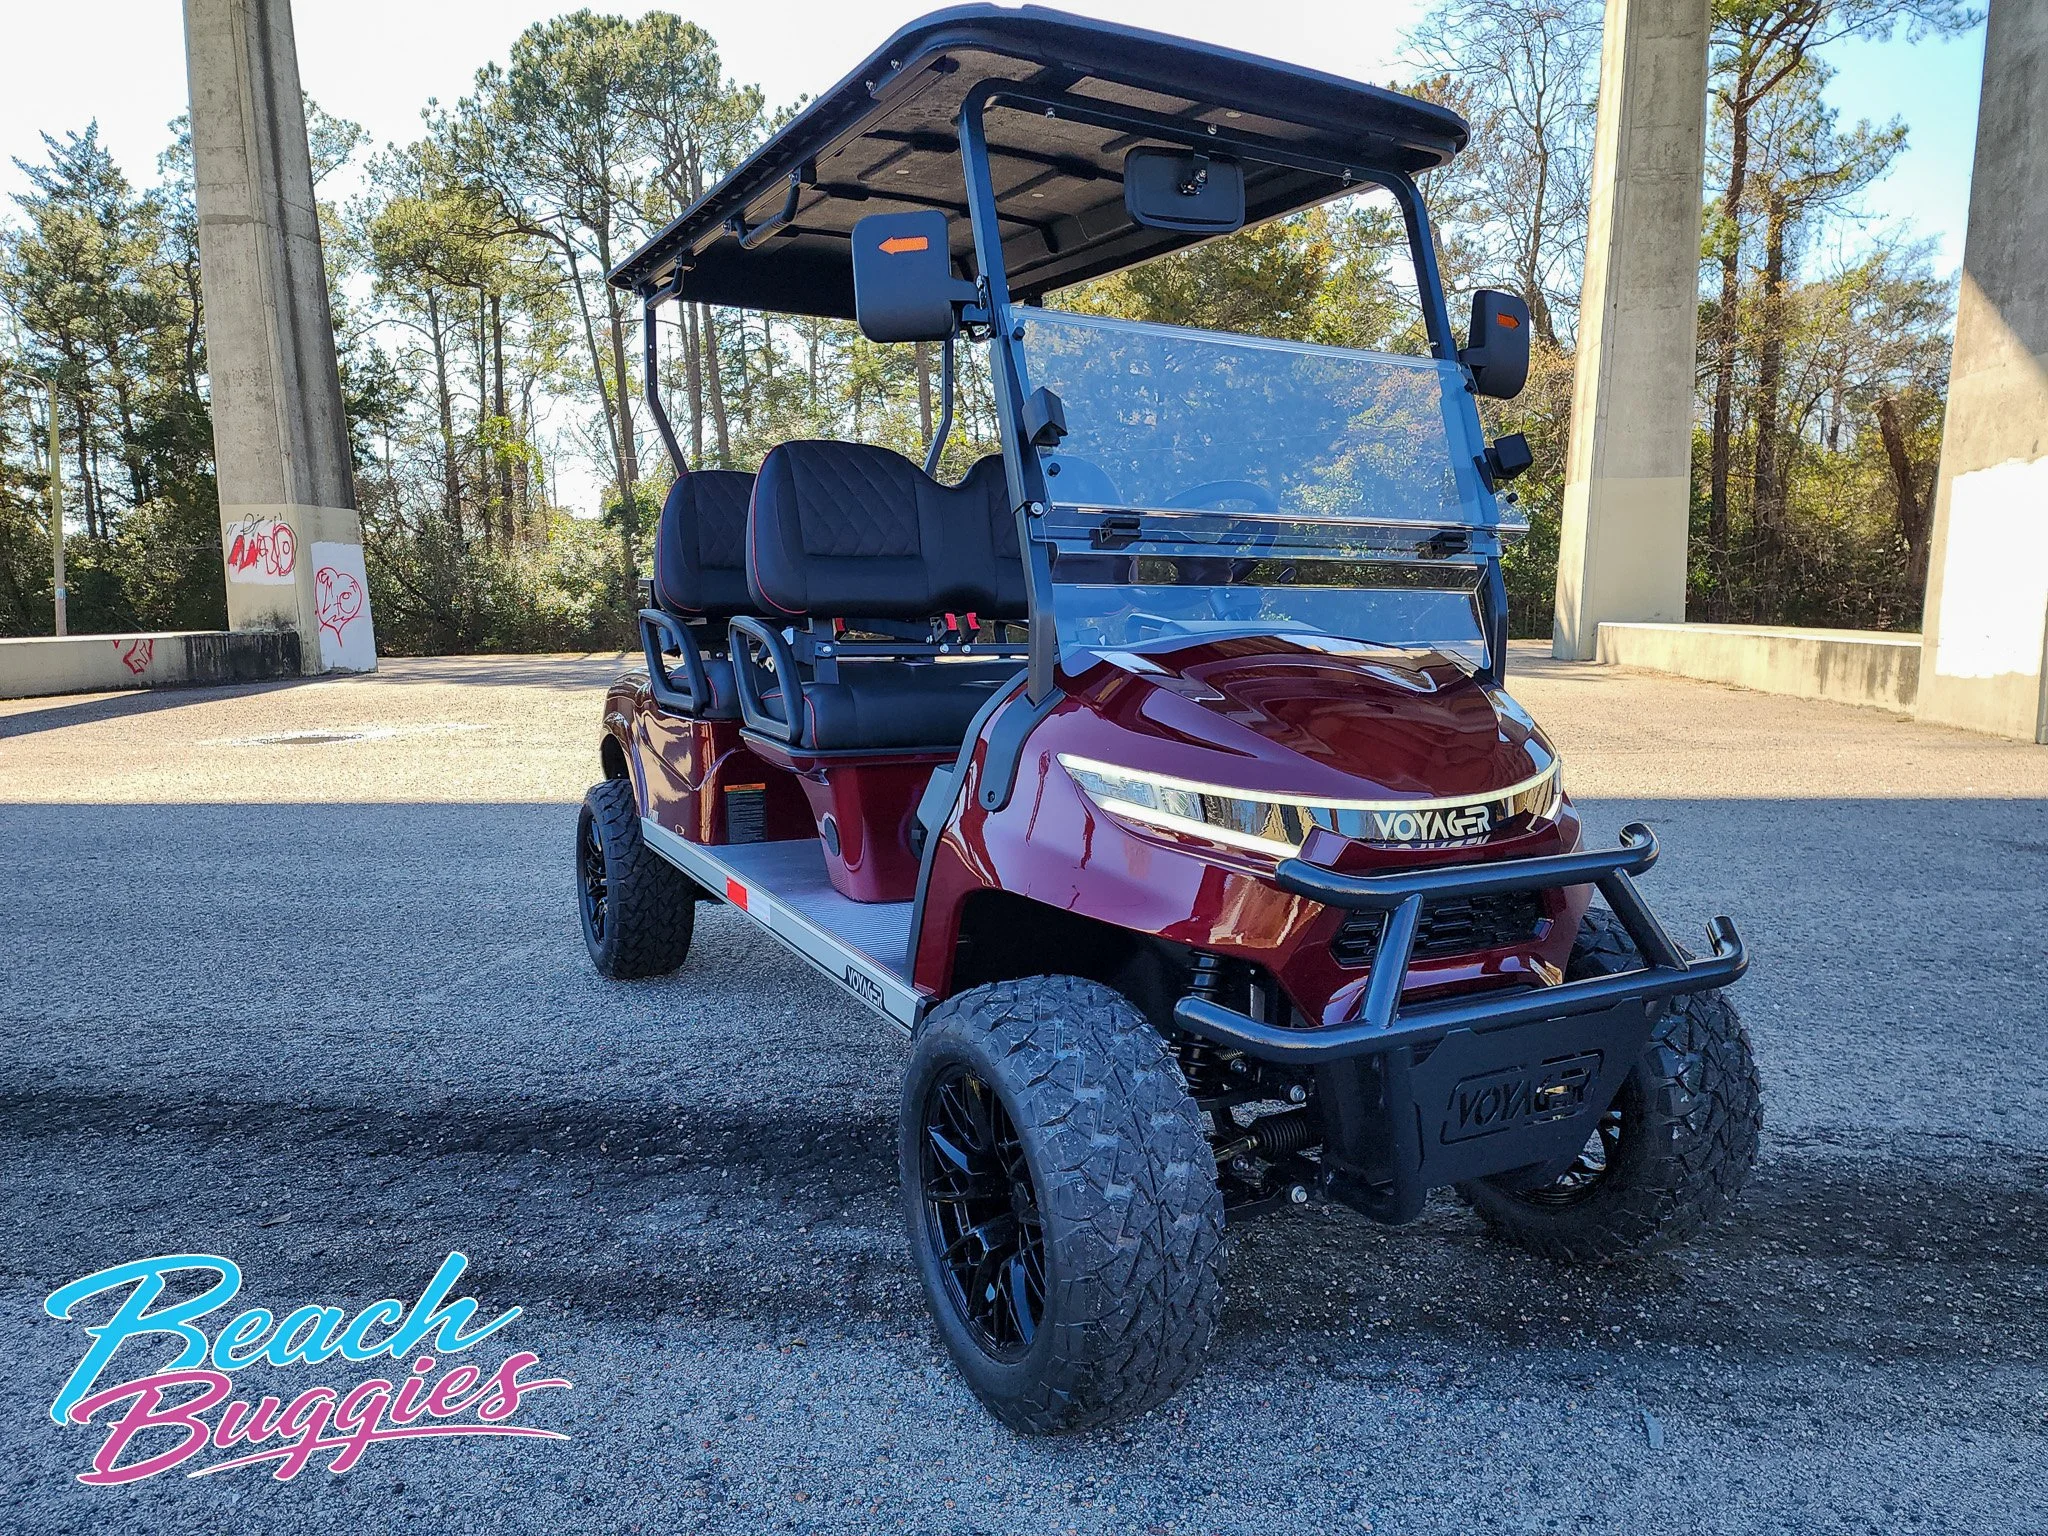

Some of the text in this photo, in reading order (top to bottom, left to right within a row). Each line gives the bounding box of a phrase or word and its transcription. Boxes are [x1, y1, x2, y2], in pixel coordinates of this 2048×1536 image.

[1373, 805, 1492, 841] VOYAGER
[847, 966, 883, 1009] VOYAGER
[1459, 1067, 1591, 1129] VOYAGER
